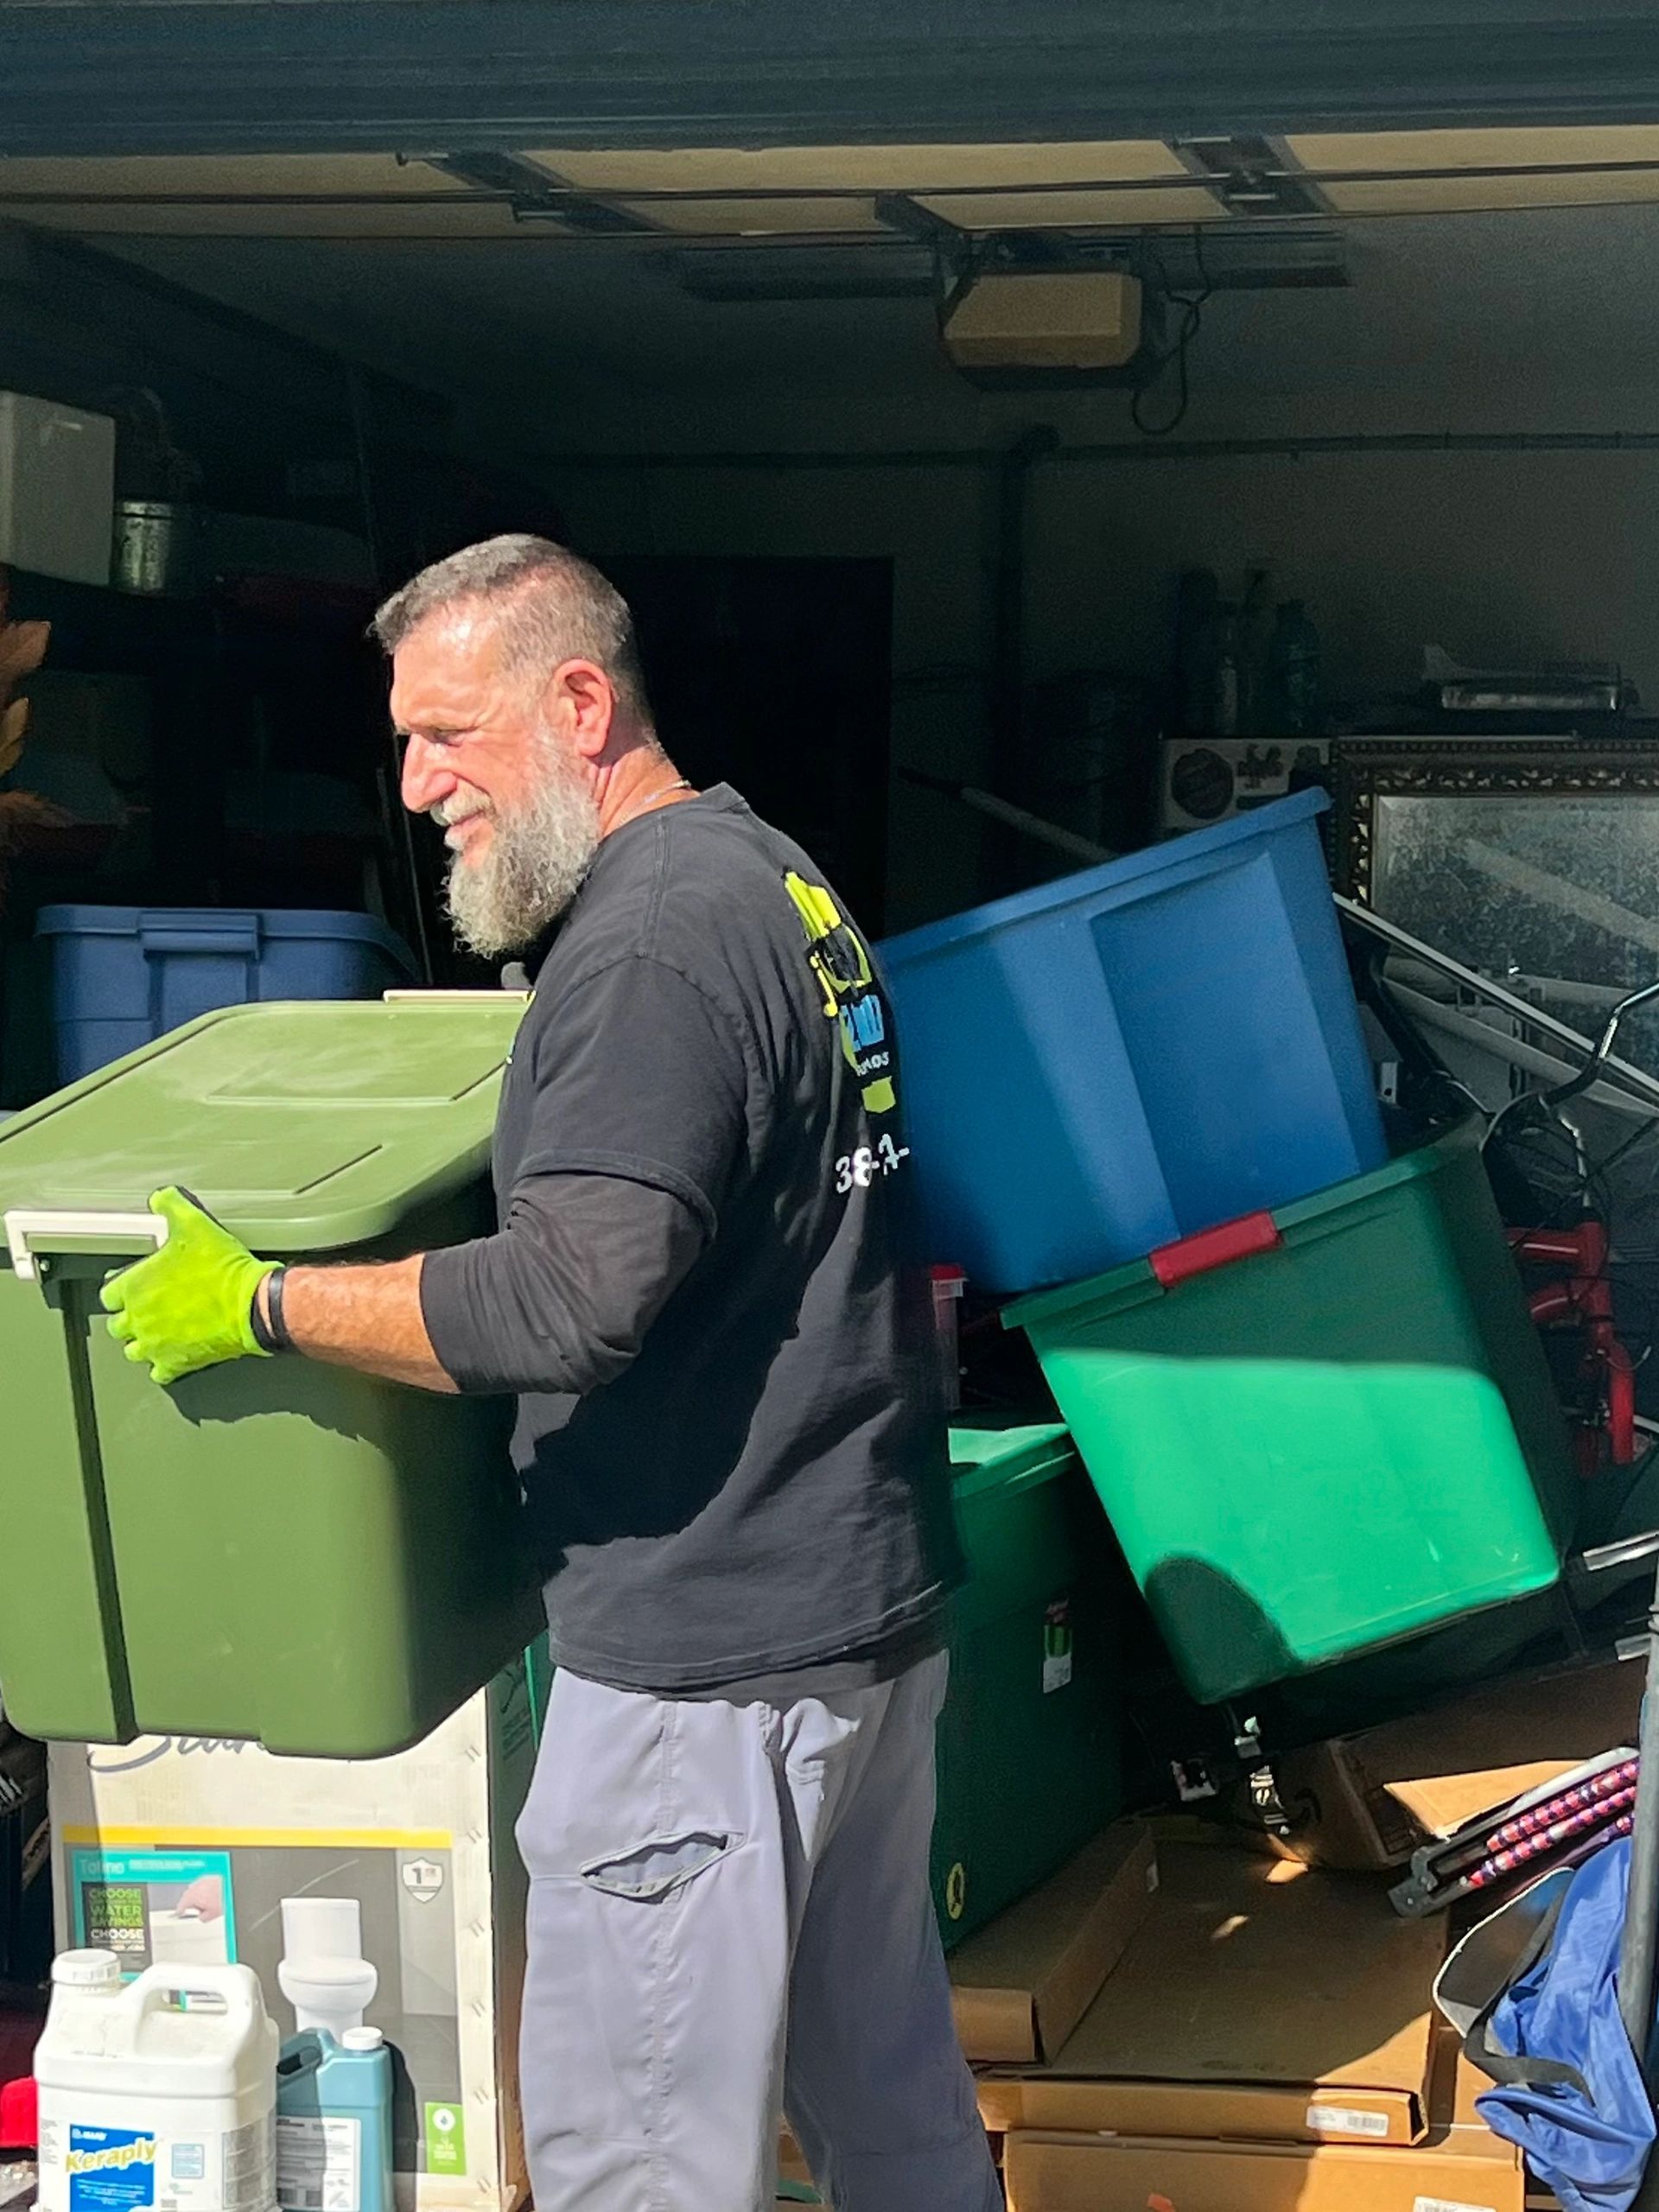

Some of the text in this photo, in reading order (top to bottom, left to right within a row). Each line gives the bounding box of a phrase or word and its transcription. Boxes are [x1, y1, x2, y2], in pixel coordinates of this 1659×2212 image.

[89, 1888, 143, 1899] CHOOSE
[90, 1904, 143, 1916] WATER
[90, 1928, 144, 1940] CHOOSE
[65, 2139, 157, 2173] Keraply
